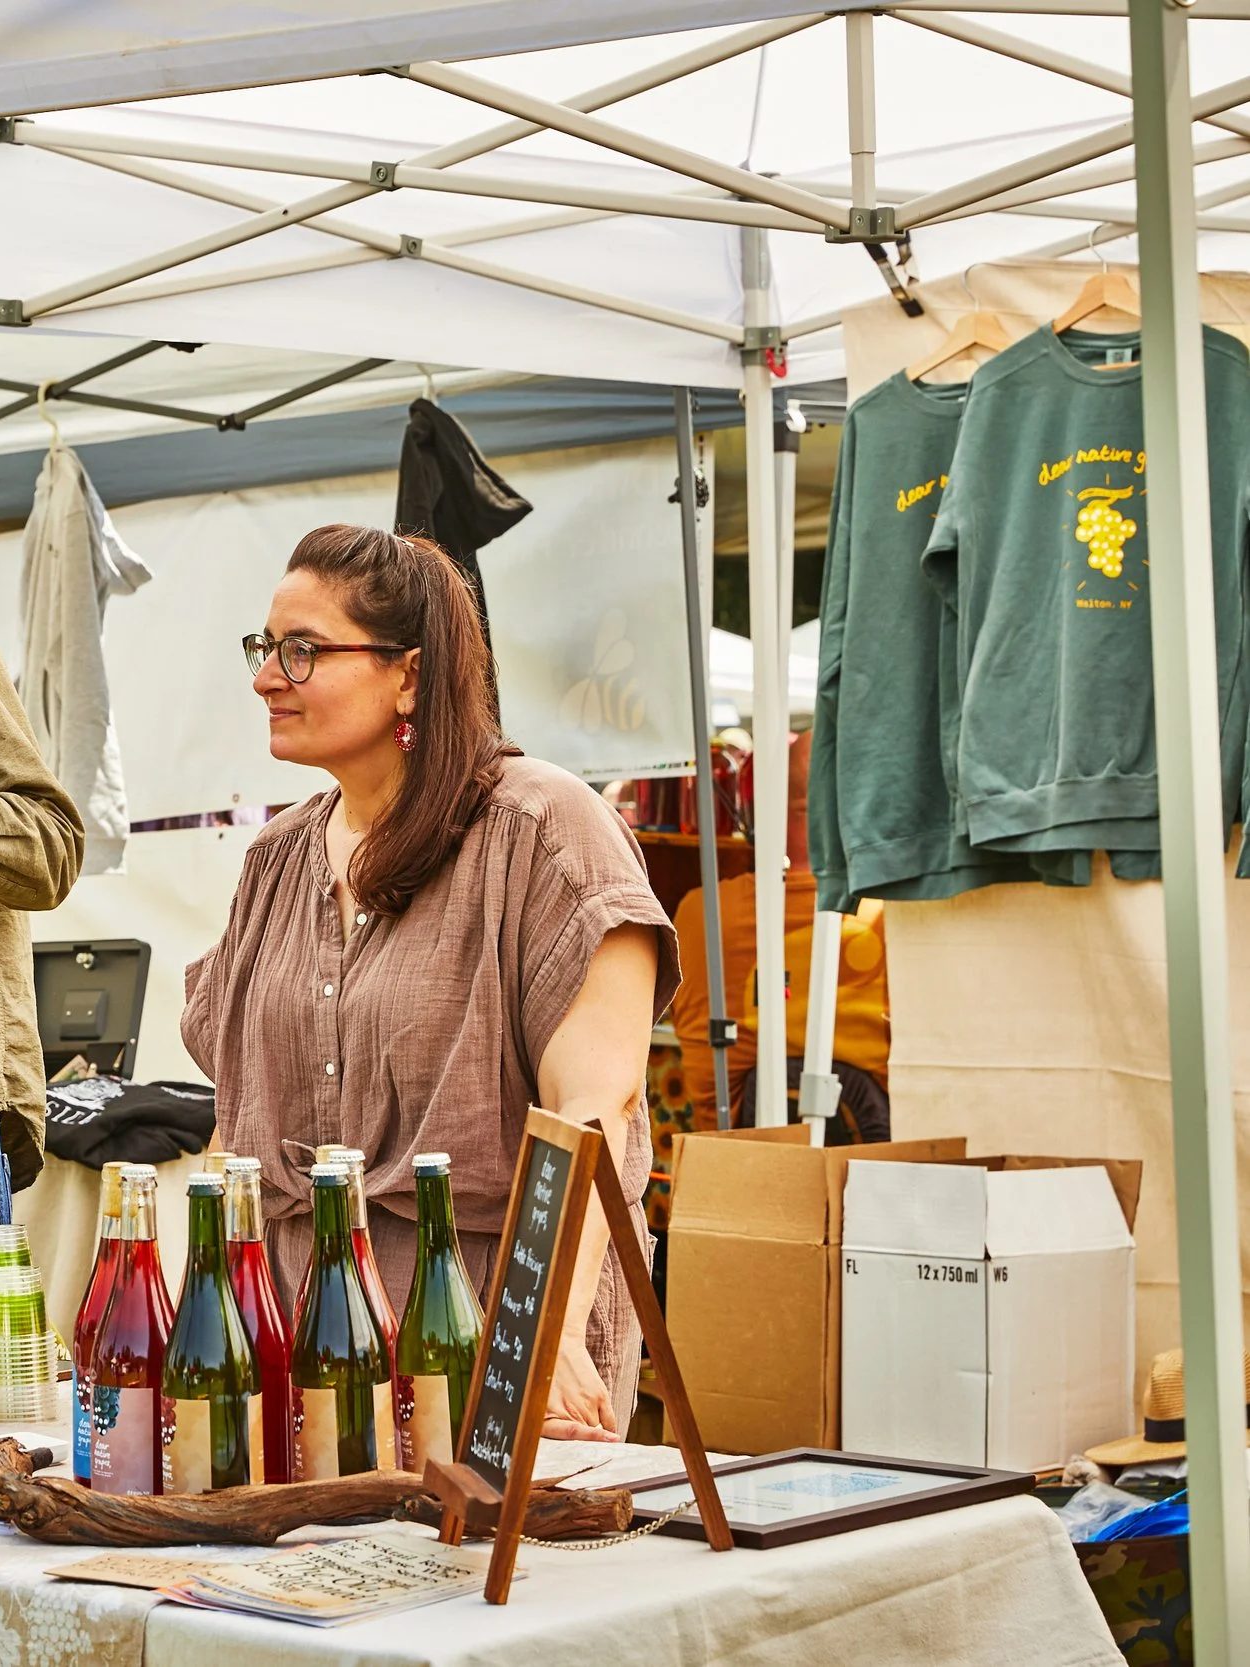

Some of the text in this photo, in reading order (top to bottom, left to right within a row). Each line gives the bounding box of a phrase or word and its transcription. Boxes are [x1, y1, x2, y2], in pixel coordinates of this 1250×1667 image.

[1039, 455, 1074, 486] dear
[1076, 445, 1132, 464] native
[897, 480, 936, 512] dear
[846, 1259, 858, 1274] FL
[918, 1264, 978, 1283] 12 x 750 ml
[993, 1267, 1008, 1282] W6
